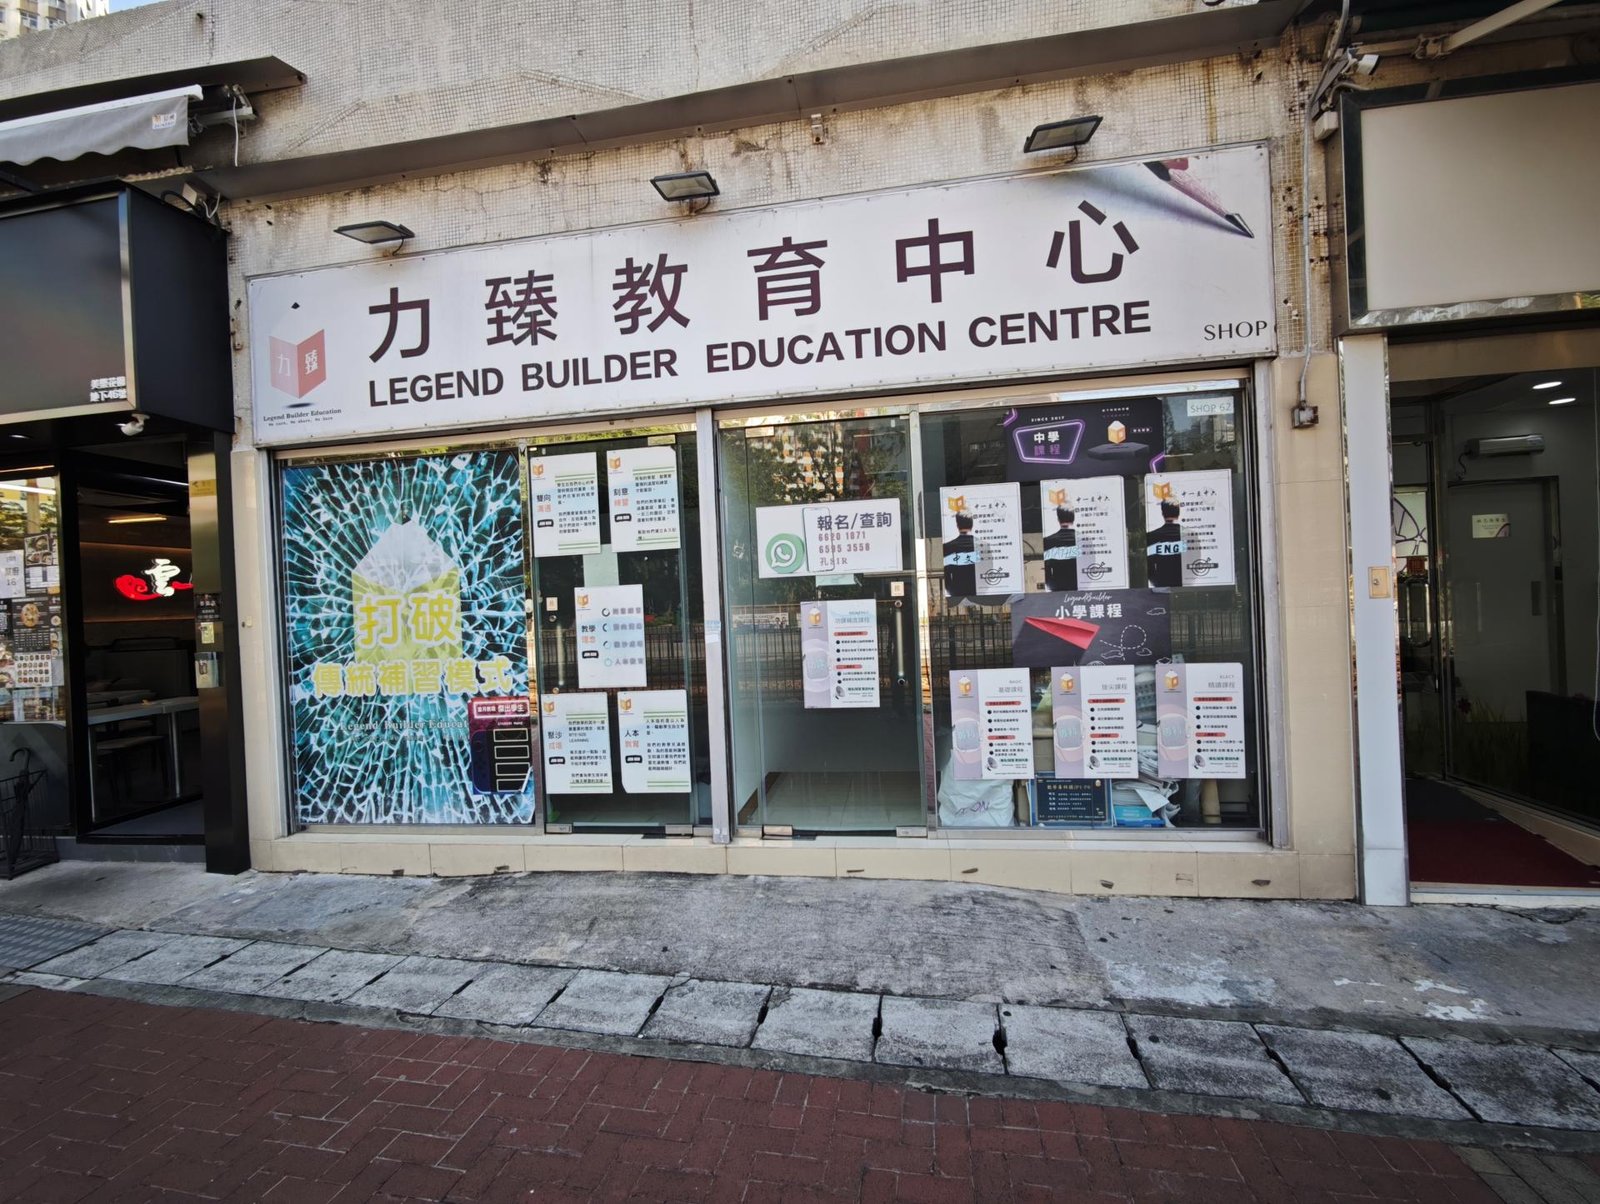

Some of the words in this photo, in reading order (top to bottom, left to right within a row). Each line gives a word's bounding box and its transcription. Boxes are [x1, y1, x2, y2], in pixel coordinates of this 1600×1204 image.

[369, 200, 1139, 363] 力臻教育中心
[1203, 320, 1268, 341] SHOP
[368, 366, 505, 407] LEGEND
[521, 348, 679, 392] BUILDER
[705, 320, 947, 373] EDUCATION
[968, 300, 1151, 347] CENTRE
[263, 413, 285, 422] Legend
[286, 411, 309, 419] Builder
[310, 408, 342, 416] Education
[1190, 404, 1217, 414] SHOP
[1218, 403, 1232, 412] 62
[1033, 431, 1060, 444] 中學
[613, 487, 629, 496] 刻意
[817, 511, 892, 531] 報名/查詢
[1156, 544, 1180, 554] ENG
[953, 552, 974, 565] 中文
[1055, 603, 1123, 620] 小學課程
[358, 594, 458, 646] 打破
[313, 656, 513, 697] 傳統補習模式
[624, 729, 639, 737] 人本
